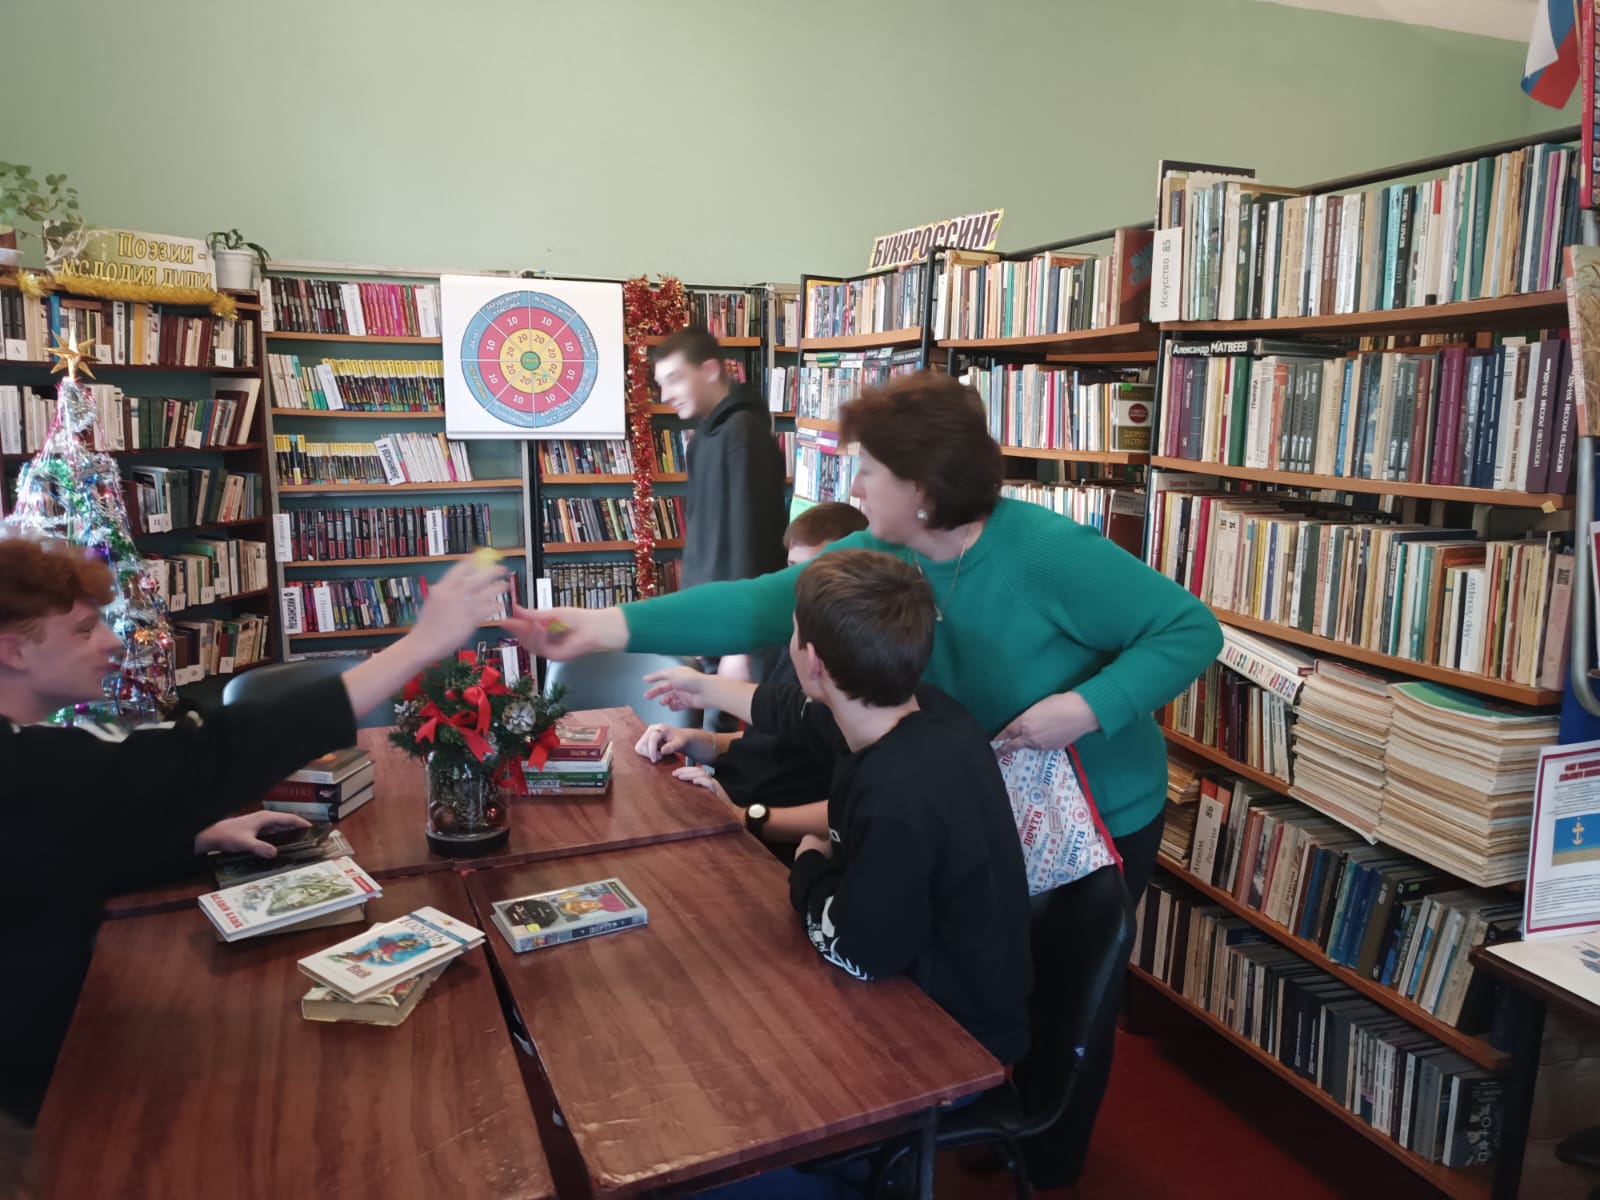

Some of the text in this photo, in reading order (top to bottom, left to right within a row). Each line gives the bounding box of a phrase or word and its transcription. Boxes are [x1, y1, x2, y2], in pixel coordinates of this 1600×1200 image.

[871, 212, 1000, 268] БУККРОССИНГ
[118, 231, 194, 264] Поэзия
[1160, 239, 1171, 308] Искусство 85
[507, 316, 519, 327] 10
[541, 316, 553, 327] 10
[517, 333, 528, 344] 20
[533, 334, 545, 345] 20
[486, 339, 496, 351] 10
[564, 341, 574, 352] 10
[1173, 340, 1248, 357] Александр МАТВЕЕВ
[506, 346, 515, 357] 20
[547, 348, 557, 359] 20
[506, 363, 517, 375] 20
[548, 363, 558, 374] 20
[488, 373, 498, 384] 10
[566, 369, 576, 380] 10
[519, 375, 531, 386] 20
[512, 394, 524, 404] 10
[545, 393, 556, 404] 10
[1205, 805, 1214, 819] 86
[1023, 810, 1043, 848] ПОЧТА
[1066, 830, 1086, 868] ПОЧТА
